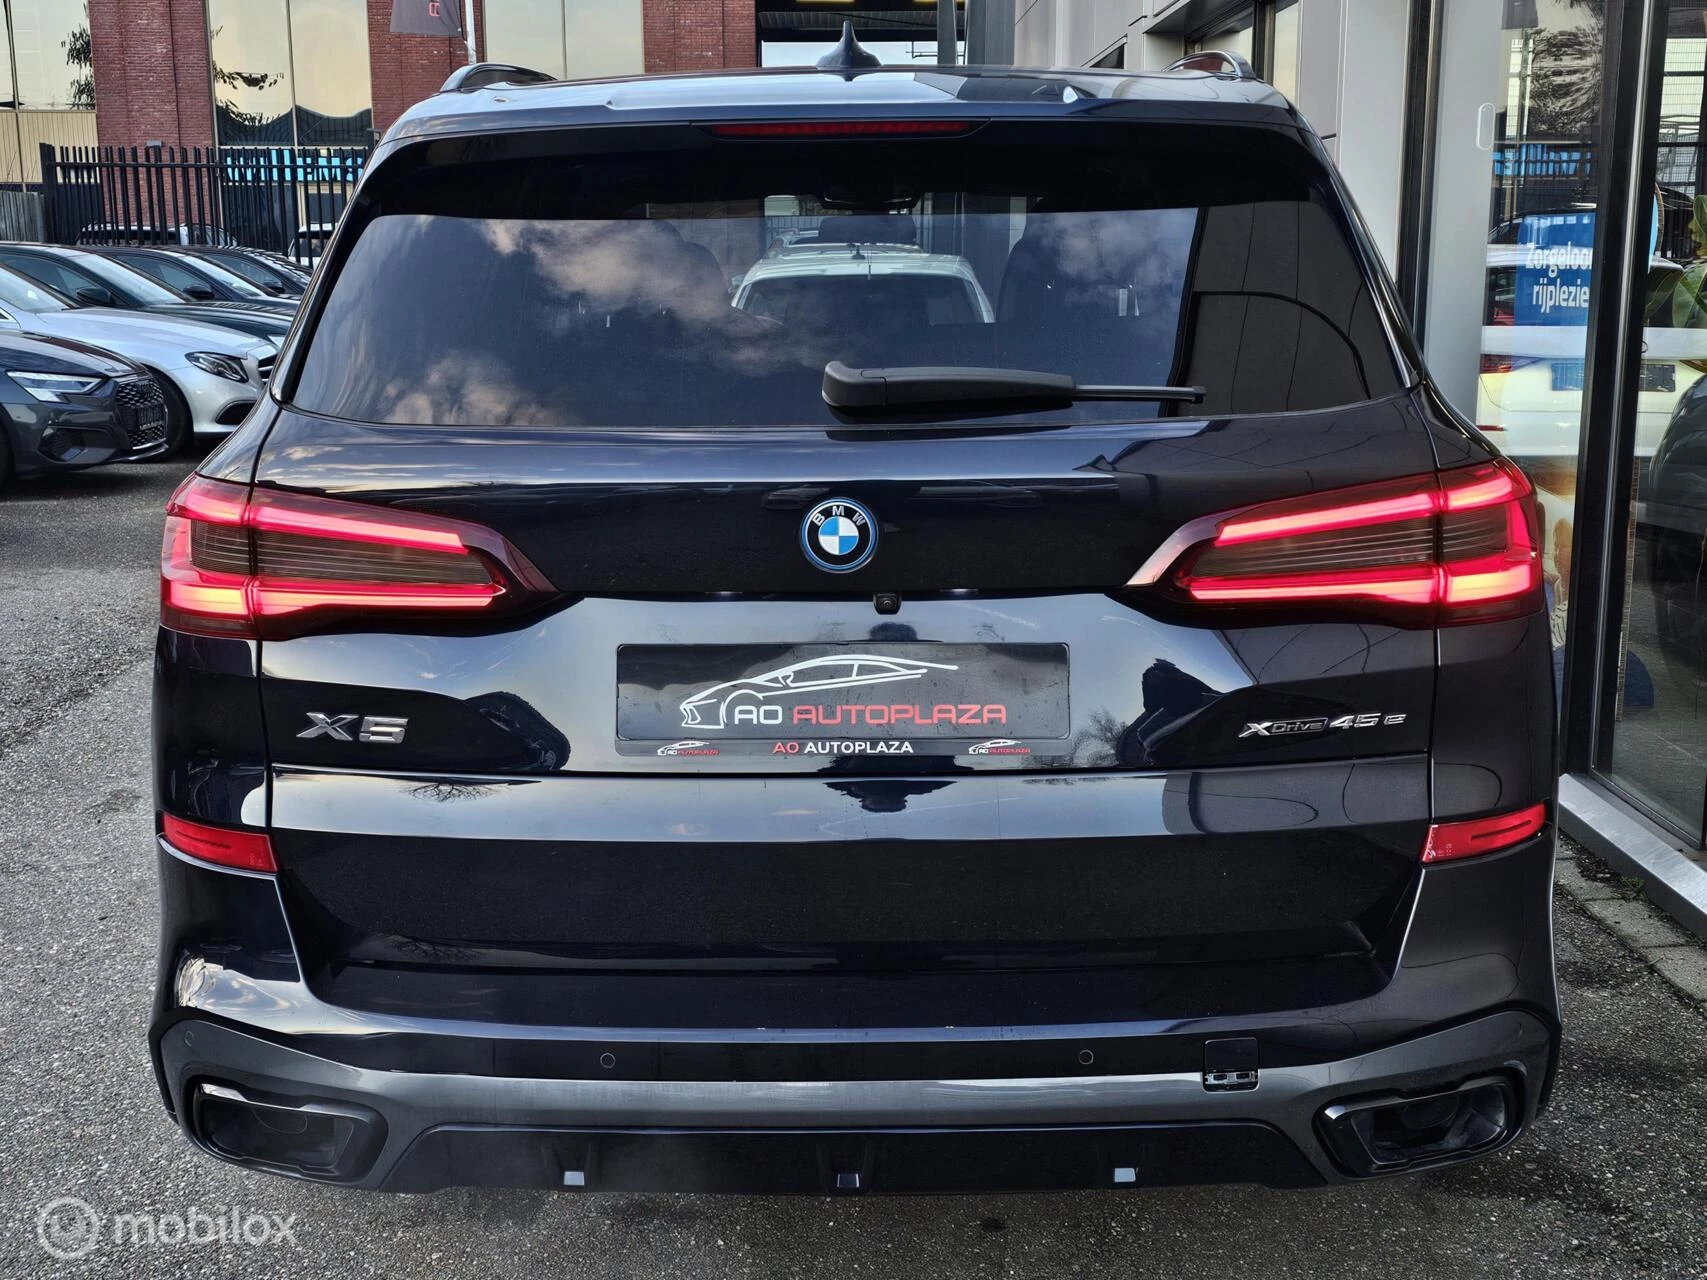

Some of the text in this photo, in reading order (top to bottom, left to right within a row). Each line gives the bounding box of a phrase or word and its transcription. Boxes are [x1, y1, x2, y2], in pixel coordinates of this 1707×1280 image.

[811, 505, 866, 526] BMW
[734, 704, 1007, 725] AO AUTOPLAZA
[296, 711, 409, 744] X5
[771, 740, 914, 755] AO AUTOPLAZA
